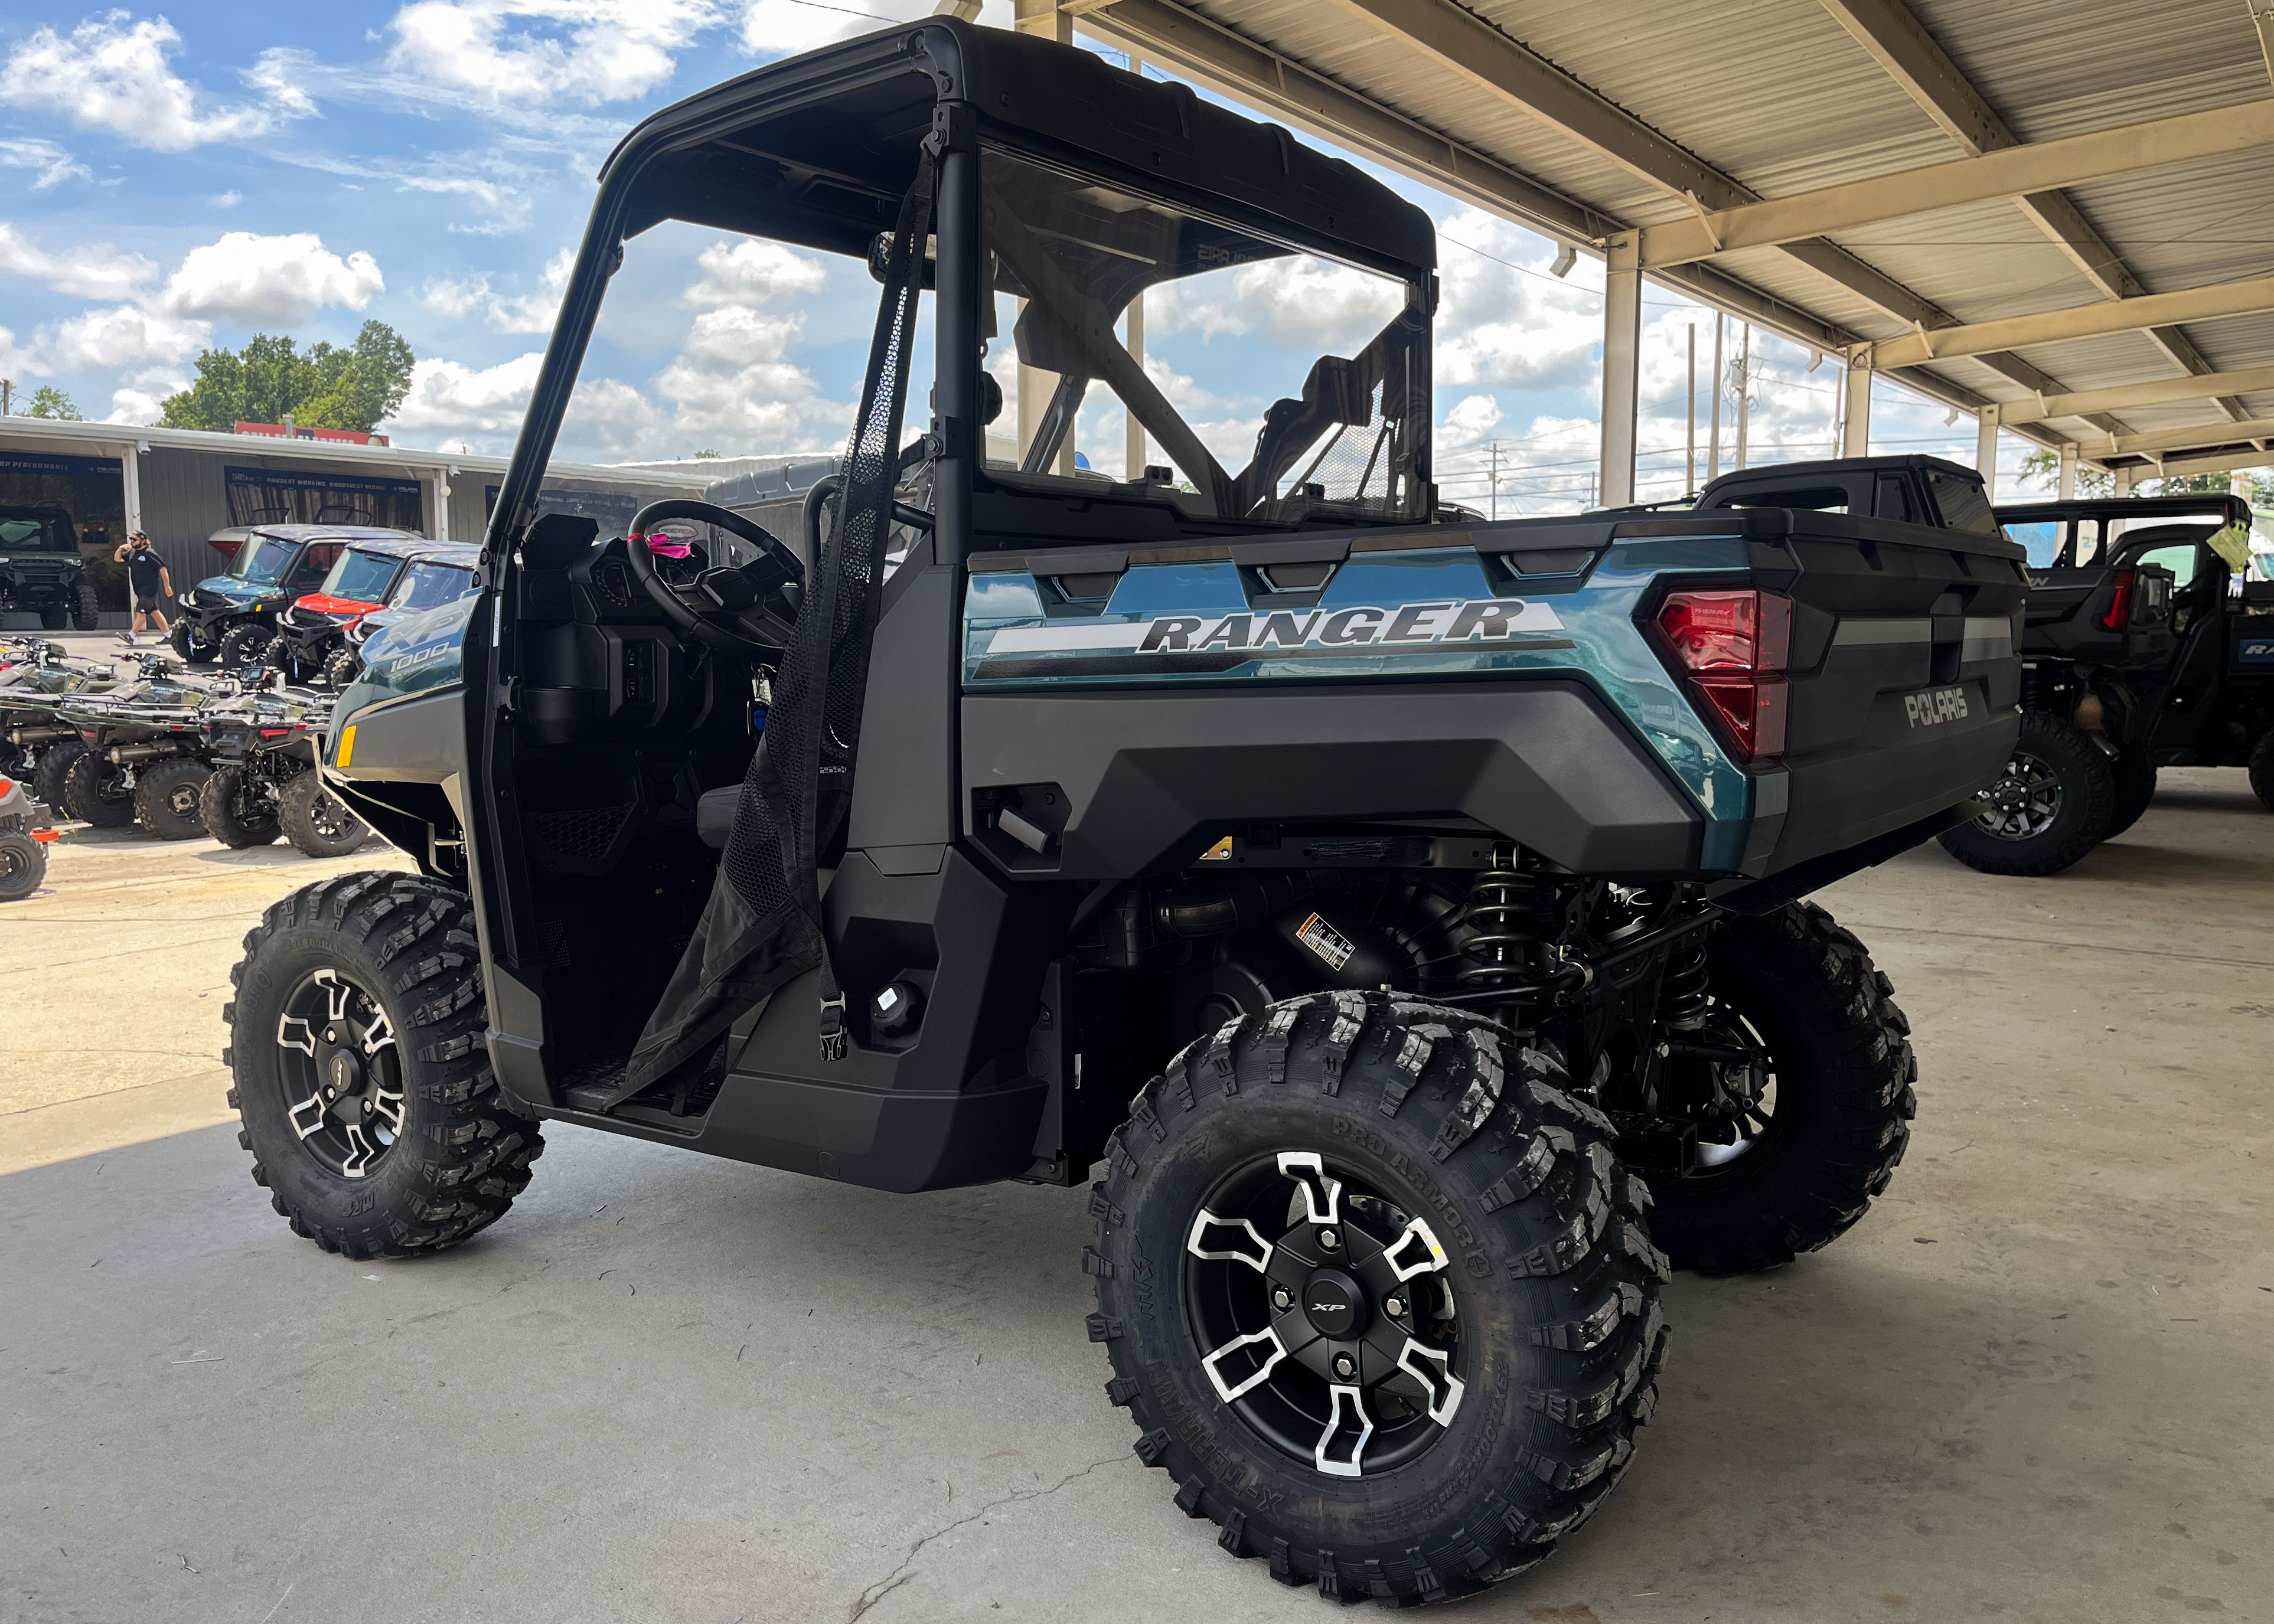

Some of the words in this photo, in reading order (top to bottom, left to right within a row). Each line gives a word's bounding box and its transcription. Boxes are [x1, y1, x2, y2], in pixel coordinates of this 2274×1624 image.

[12, 461, 70, 470] PERFORMANCE
[329, 481, 363, 489] SMOOTHEST
[377, 609, 467, 660] XP
[1135, 597, 1528, 655] RANGER
[390, 641, 450, 672] 1000
[1904, 687, 1968, 728] POLARIS
[1300, 914, 1317, 933] WARNING
[1332, 1116, 1387, 1156] PRO
[1390, 1151, 1474, 1249] ARMOR
[1311, 1303, 1346, 1312] XP
[1146, 1359, 1285, 1520] X-TERRAIN
